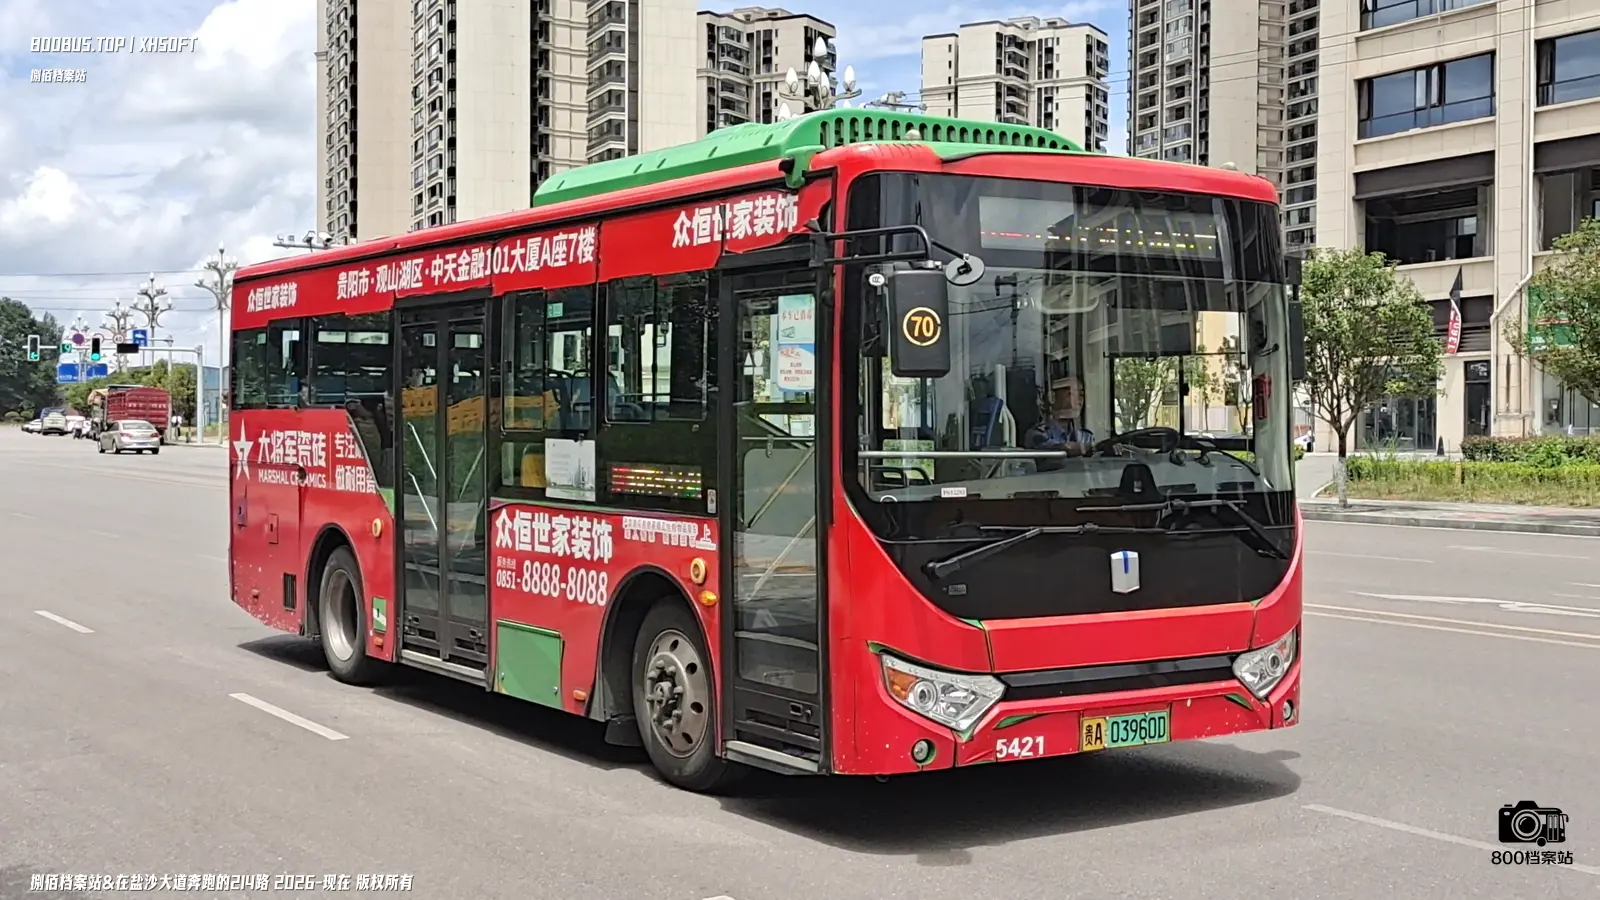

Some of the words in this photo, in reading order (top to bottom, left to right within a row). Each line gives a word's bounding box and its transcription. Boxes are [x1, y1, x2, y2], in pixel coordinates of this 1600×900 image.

[672, 194, 799, 248] 众恒世家装饰
[336, 227, 596, 301] 贵阳市·观山湖区·中天金融101大厦A座7楼
[246, 282, 298, 313] 众恒世家装饰
[911, 316, 934, 337] 70
[258, 430, 326, 468] 大将军瓷砖
[258, 469, 289, 485] MARSHAL
[495, 509, 613, 564] 众恒世家装饰
[496, 559, 609, 607] 0851-8888-8088
[996, 735, 1045, 759] 5421
[1084, 721, 1104, 747] 贵A
[1110, 715, 1167, 744] 03960D
